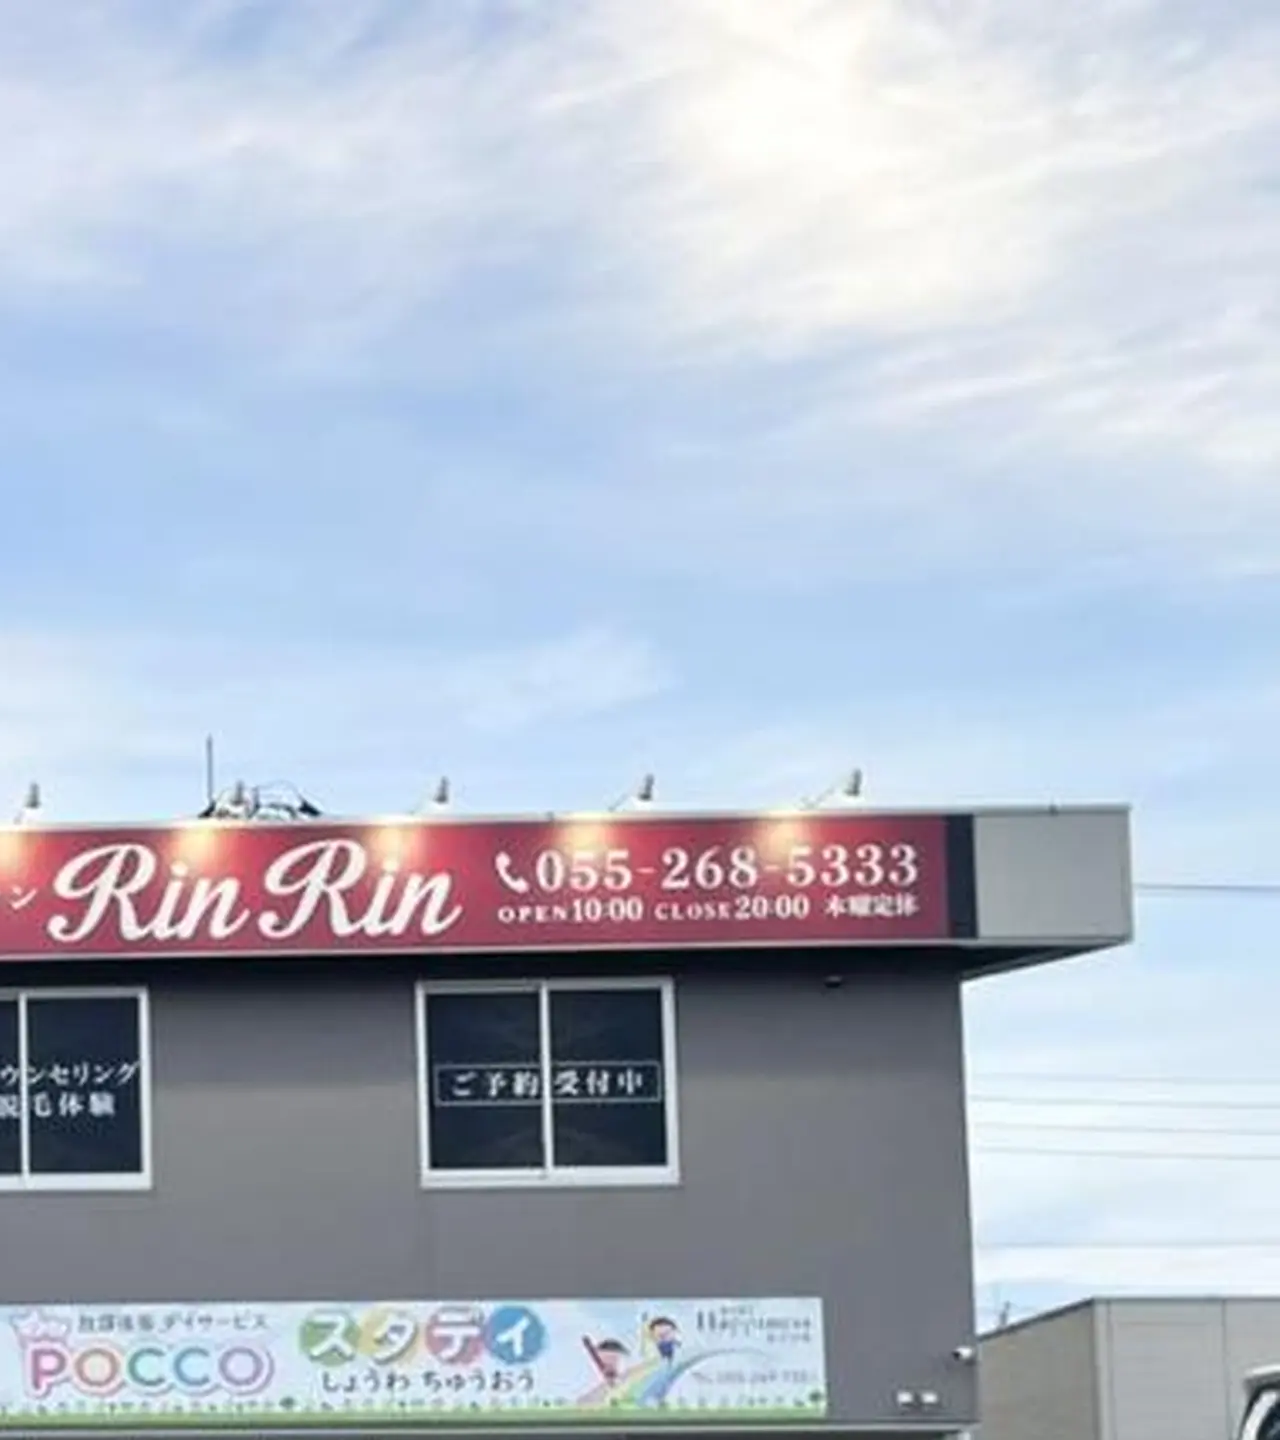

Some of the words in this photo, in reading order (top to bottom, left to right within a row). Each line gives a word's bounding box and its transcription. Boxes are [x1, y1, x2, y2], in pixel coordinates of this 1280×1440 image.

[46, 841, 250, 943] Rin
[257, 838, 462, 939] Rin
[535, 843, 919, 893] 055-268-5333
[452, 1068, 643, 1098] ご予約受付中
[28, 1346, 268, 1393] POCCO
[321, 1369, 410, 1392] しょうわ
[422, 1369, 535, 1392] ちゅうおう
